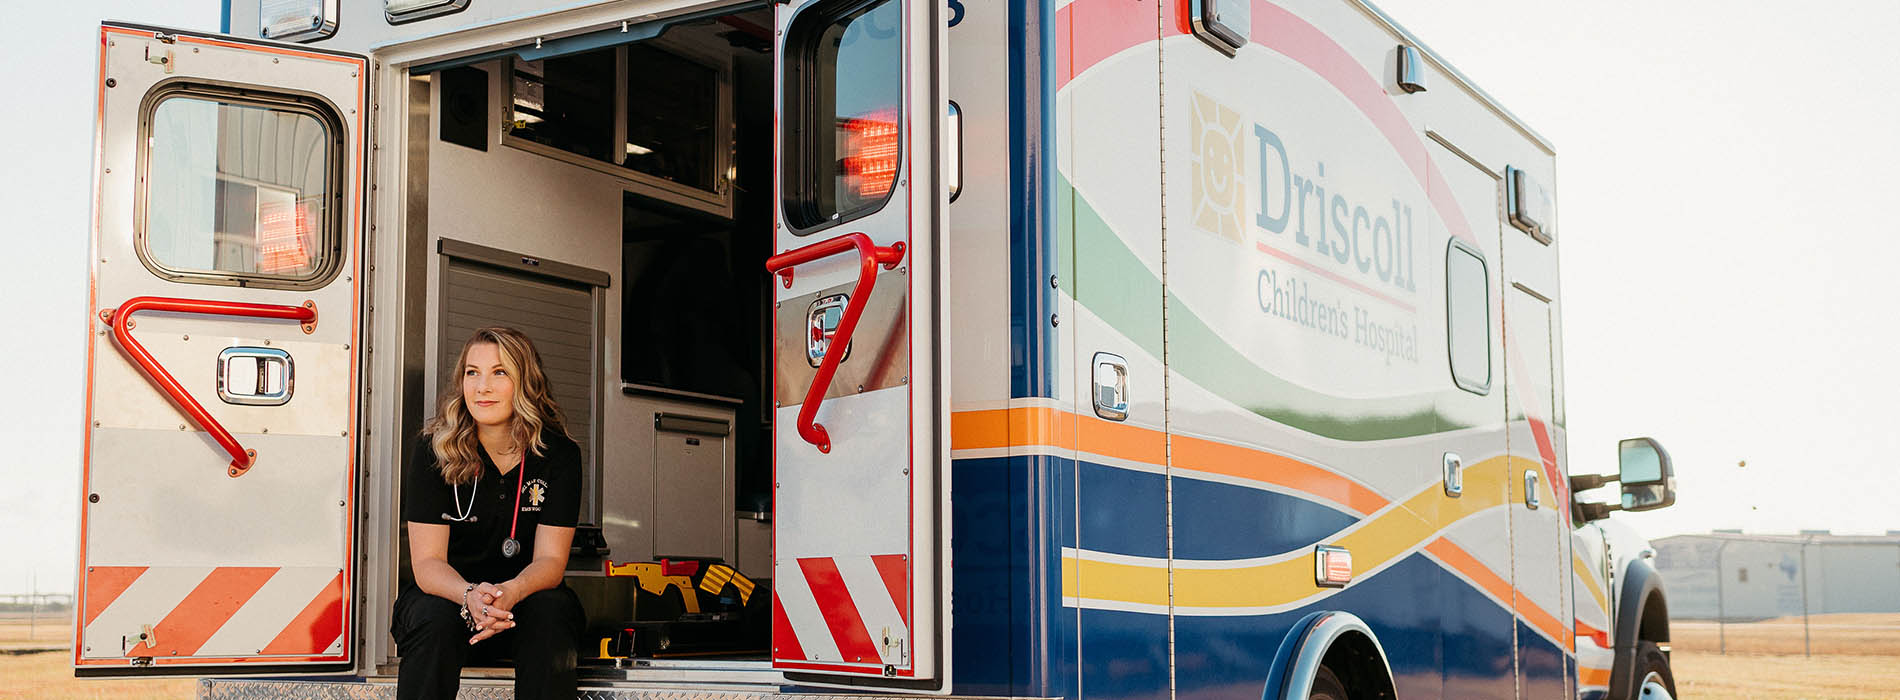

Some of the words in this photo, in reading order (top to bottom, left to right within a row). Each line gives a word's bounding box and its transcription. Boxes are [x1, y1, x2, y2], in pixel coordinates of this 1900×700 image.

[1254, 122, 1416, 293] Driscoll
[1257, 269, 1348, 339] Children's
[1354, 306, 1418, 366] Hospital
